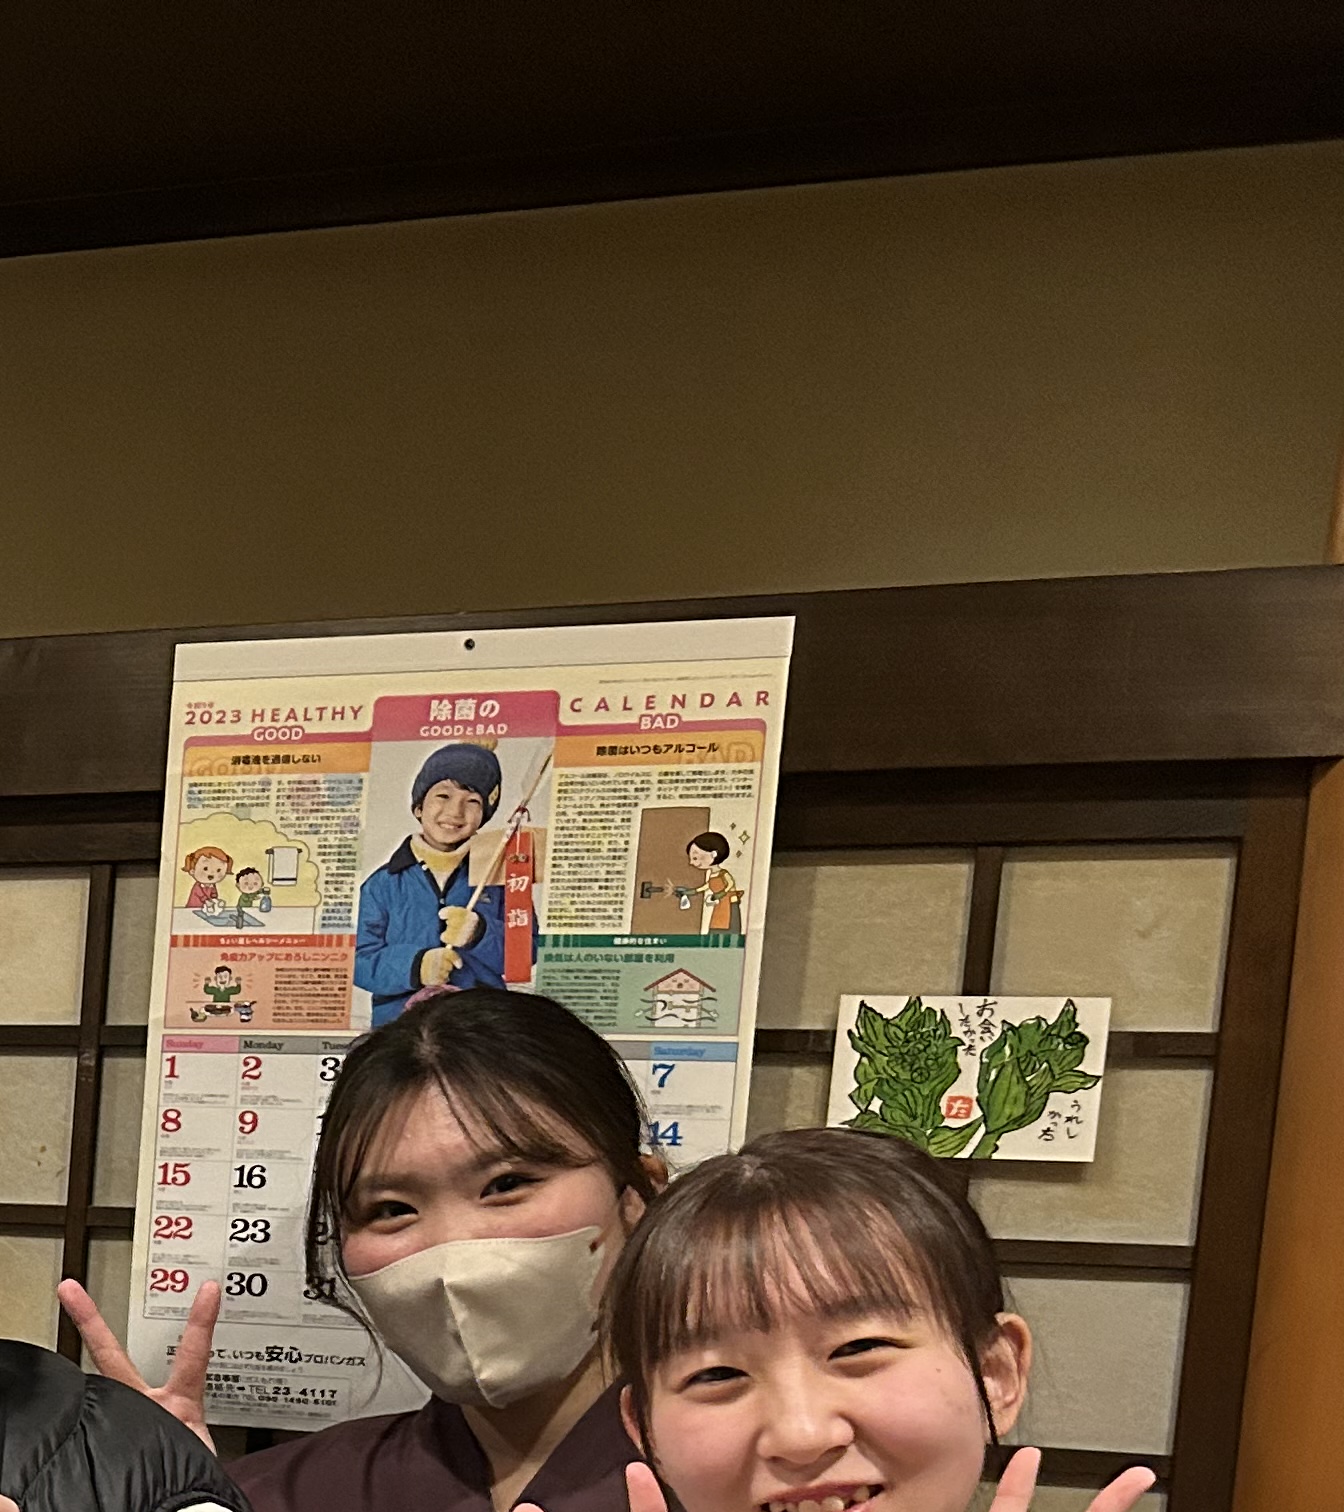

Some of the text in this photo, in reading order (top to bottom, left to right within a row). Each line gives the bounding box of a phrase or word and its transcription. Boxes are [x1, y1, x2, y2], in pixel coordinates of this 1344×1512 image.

[185, 690, 770, 726] 2023 HEALTHY CALENDAR
[429, 698, 500, 721] 除菌の
[253, 728, 304, 742] GOOD
[639, 715, 680, 731] BAD
[166, 1040, 204, 1050] Sunday
[243, 1040, 285, 1050] Monday
[654, 1046, 706, 1057] Saturday
[165, 1055, 675, 1088] 1 2 3 7
[161, 1108, 683, 1146] 8 9 14
[157, 1162, 267, 1189] 15 16
[153, 1215, 193, 1240] 22
[229, 1218, 271, 1243] 23
[149, 1268, 189, 1293] 29
[225, 1272, 268, 1297] 30
